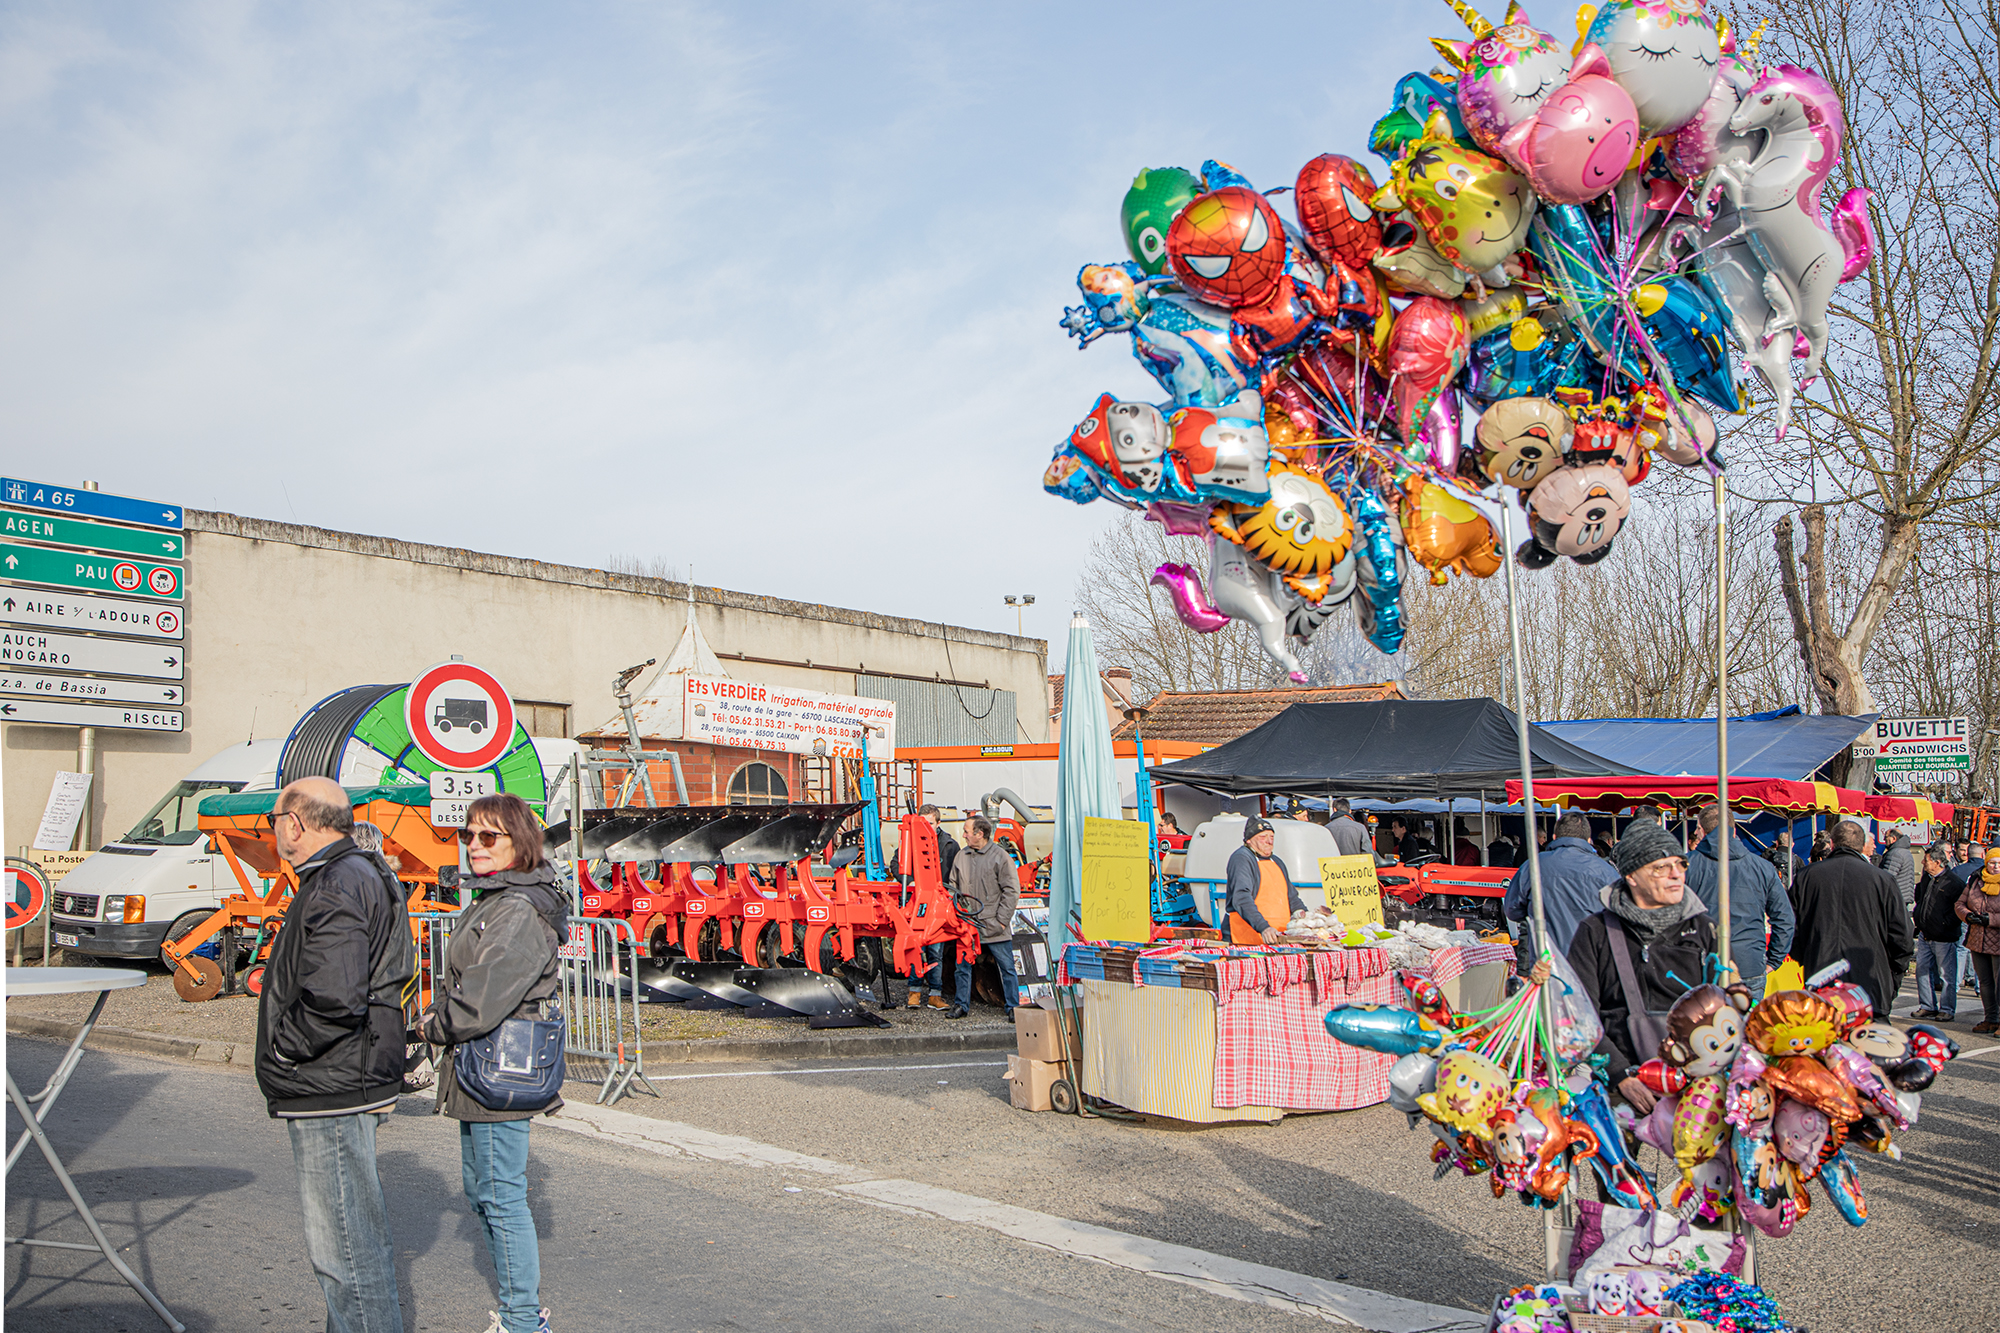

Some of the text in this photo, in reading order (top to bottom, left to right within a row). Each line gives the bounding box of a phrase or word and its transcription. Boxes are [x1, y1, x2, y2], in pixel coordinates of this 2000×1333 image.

[33, 489, 75, 507] A 65
[5, 517, 54, 536] AGEN
[75, 563, 107, 580] PAU
[26, 601, 65, 616] AIRE
[3, 634, 47, 648] AUCH
[2, 648, 70, 664] NOGARO
[1, 679, 107, 695] z.a. de Bassia
[688, 678, 709, 695] Ets
[770, 693, 817, 709] Irrigation,
[817, 701, 857, 714] matériel
[858, 706, 894, 719] agricole
[123, 712, 178, 726] RISCLE
[719, 701, 730, 711] 38,
[731, 704, 752, 713] route
[754, 705, 764, 714] de
[766, 707, 773, 715] la
[776, 709, 792, 718] gare
[801, 711, 822, 721] 65700
[700, 723, 711, 732] 28,
[726, 725, 747, 735] longue
[755, 729, 774, 737] 65500
[775, 731, 800, 740] CAIXON
[712, 712, 870, 740] Tél: 05.62.31.53.21 Port: 06.85.80.39.3
[1876, 719, 1966, 738] BUVETTE
[711, 734, 787, 751] Tél: 05.62.96.75.13
[1891, 743, 1967, 755] SANDWICHS
[1888, 756, 1912, 764] Comité
[1925, 761, 1968, 769] BOURDALAT
[1882, 771, 1956, 783] VIN CHAUD
[437, 814, 465, 823] DESS
[43, 855, 85, 863] La Poste
[1123, 865, 1133, 892] 3
[1329, 884, 1378, 900] D'AUVERGNE
